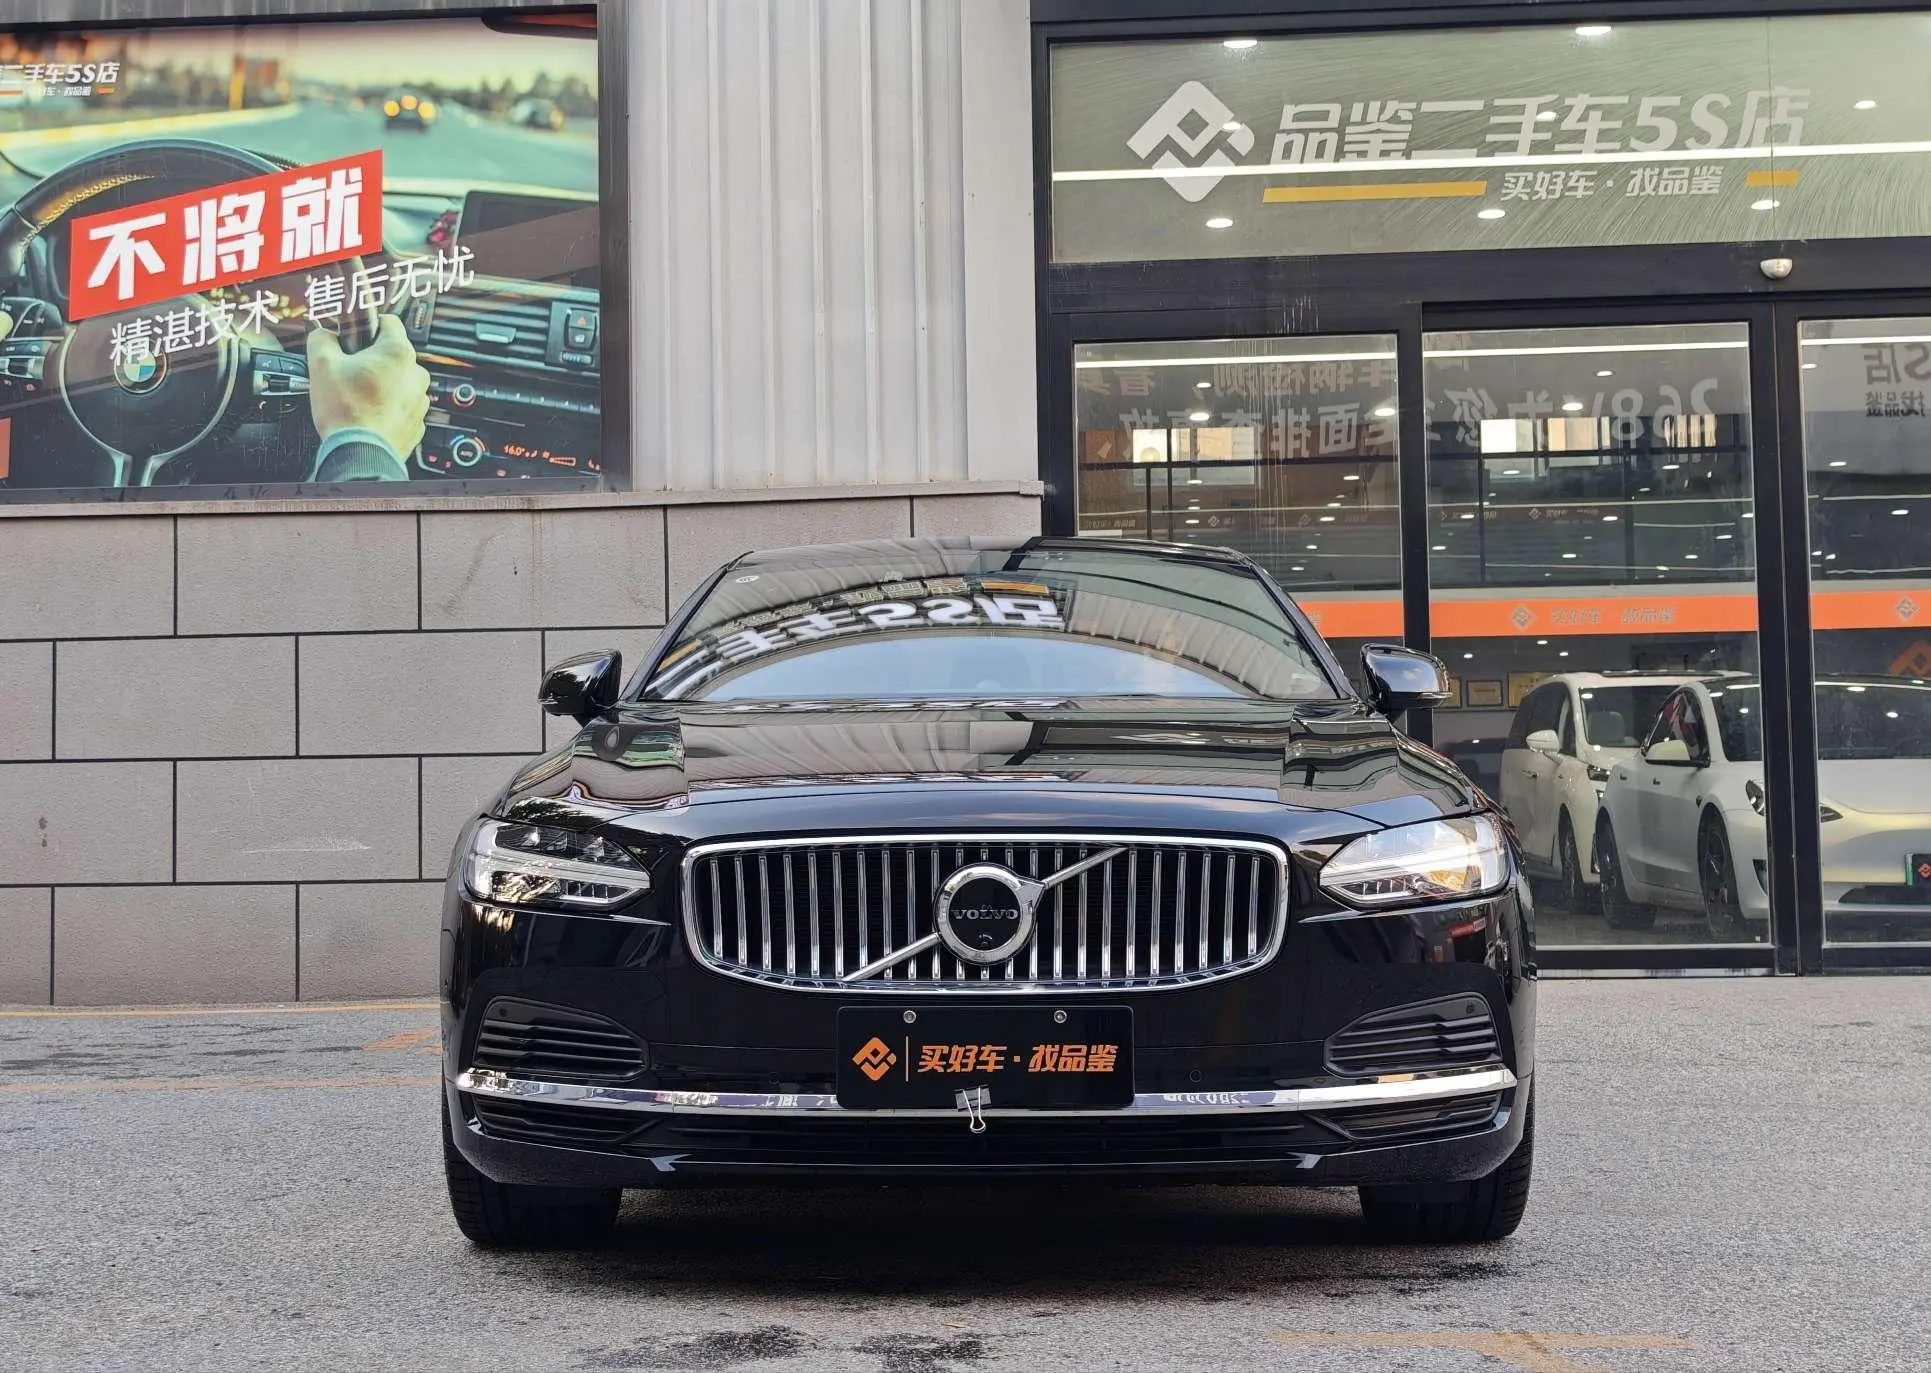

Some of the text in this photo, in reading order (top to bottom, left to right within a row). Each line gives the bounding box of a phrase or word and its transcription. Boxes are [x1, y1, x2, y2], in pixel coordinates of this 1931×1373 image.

[1269, 86, 1811, 166] 品鉴二手车5S店
[87, 166, 363, 301] 不将就
[109, 246, 477, 364] 精湛技术 售后无忧
[950, 908, 1019, 920] VOLVO
